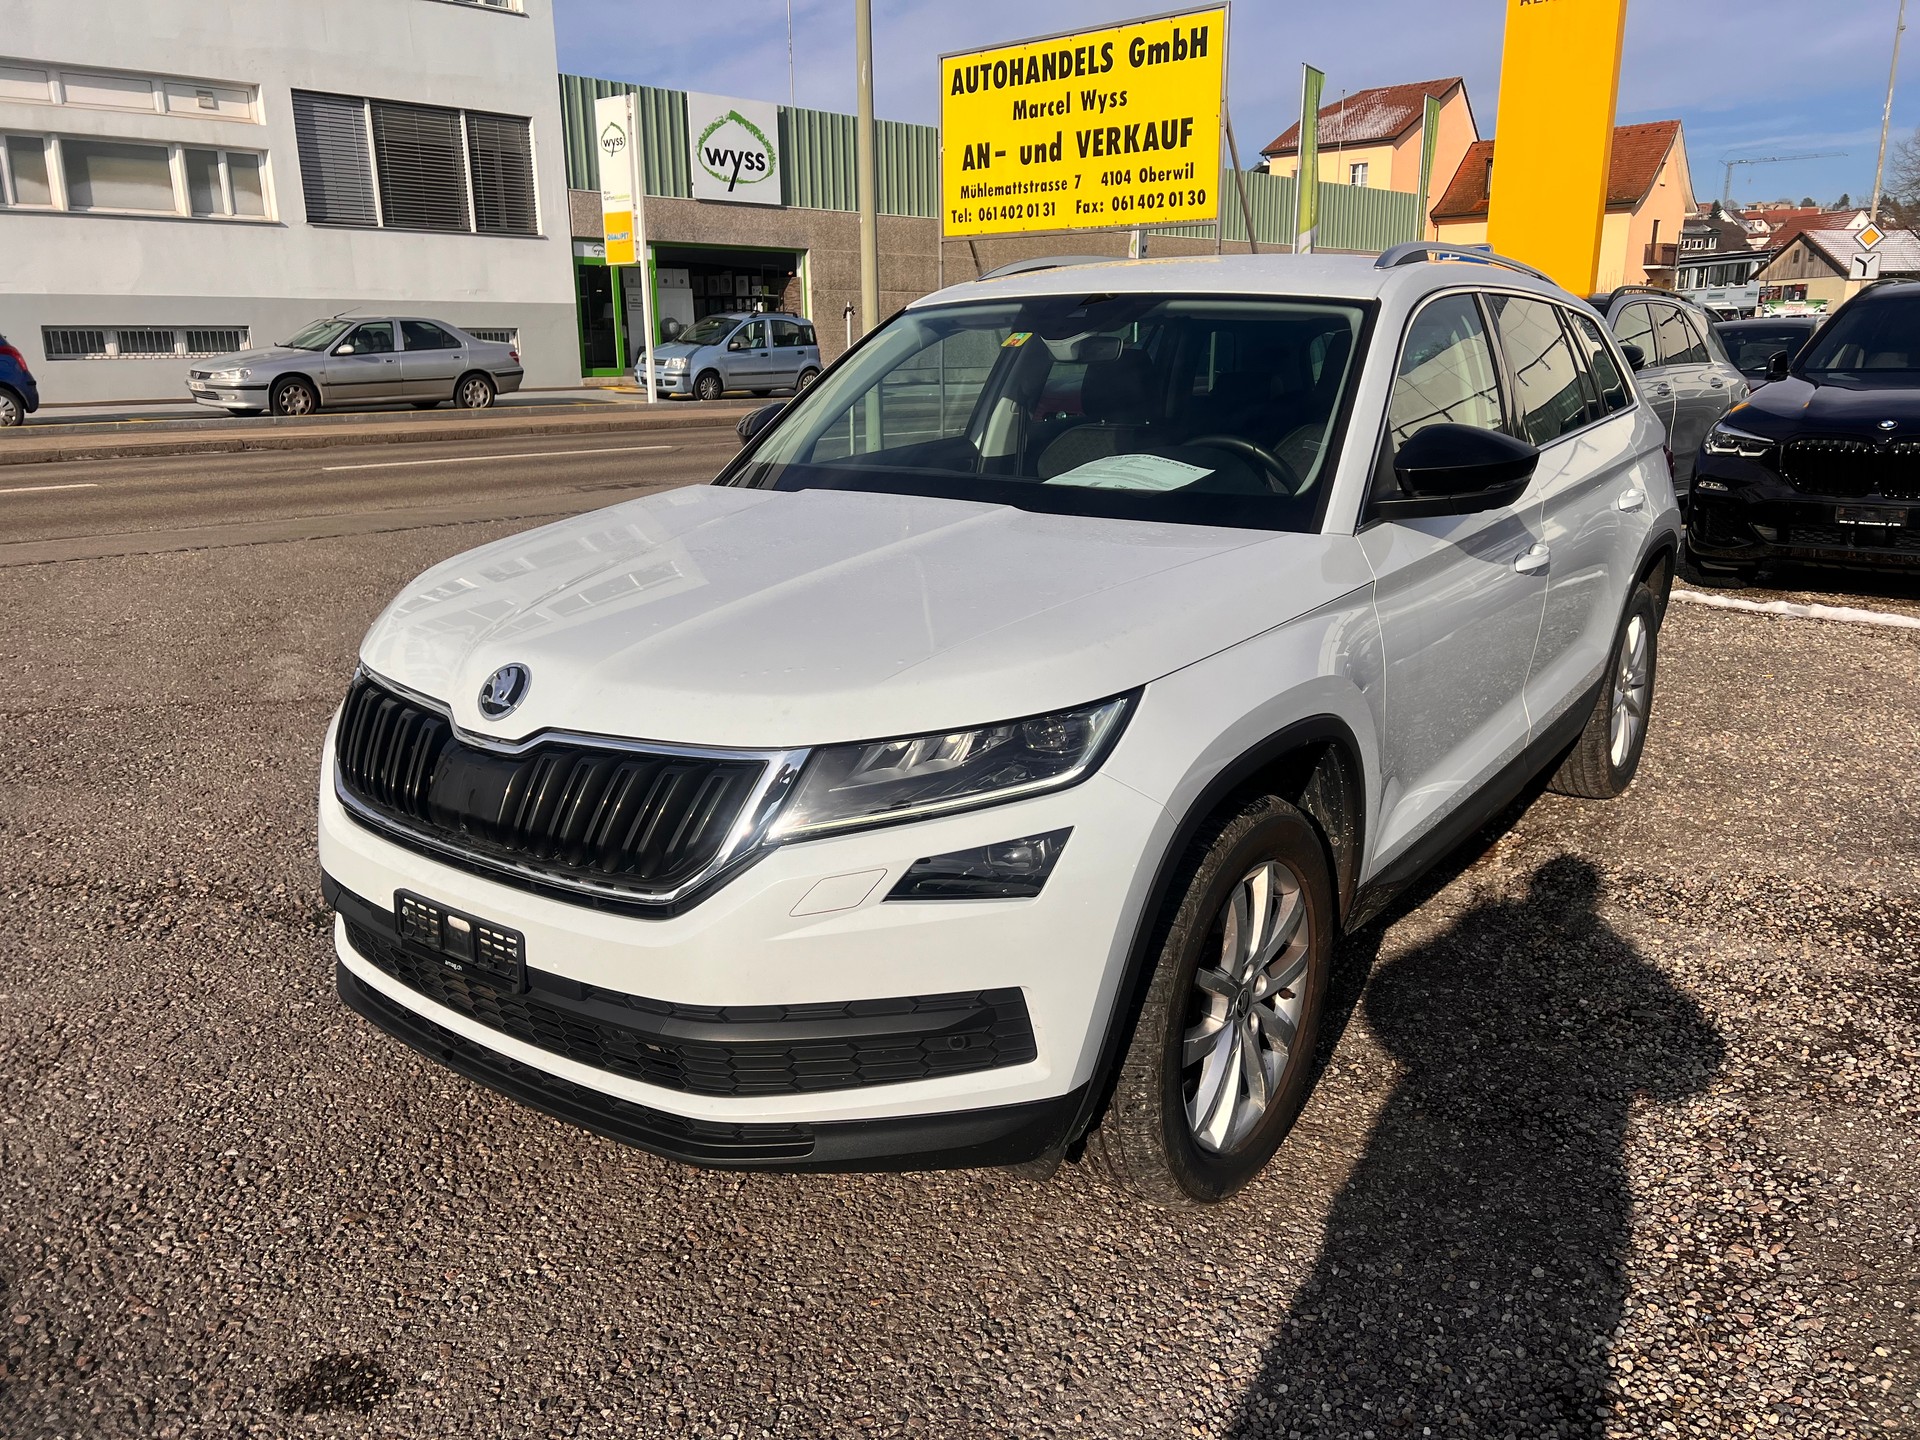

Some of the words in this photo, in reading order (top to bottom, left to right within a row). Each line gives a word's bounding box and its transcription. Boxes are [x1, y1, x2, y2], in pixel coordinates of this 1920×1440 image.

[951, 42, 1114, 96] AUTOHANDELS
[1129, 26, 1209, 68] GmbH
[1012, 91, 1071, 121] Marcel
[1081, 90, 1128, 114] Wyss
[962, 142, 1006, 171] AN-
[1020, 131, 1062, 166] und
[1076, 117, 1194, 159] VERKAUF
[704, 146, 766, 193] wyss
[960, 179, 1068, 200] Mühlemattstrasse
[1074, 175, 1082, 190] 7
[1101, 169, 1132, 187] 4104
[1139, 162, 1195, 183] Oberwil
[951, 207, 972, 224] Tel:
[1076, 199, 1104, 214] Fax:
